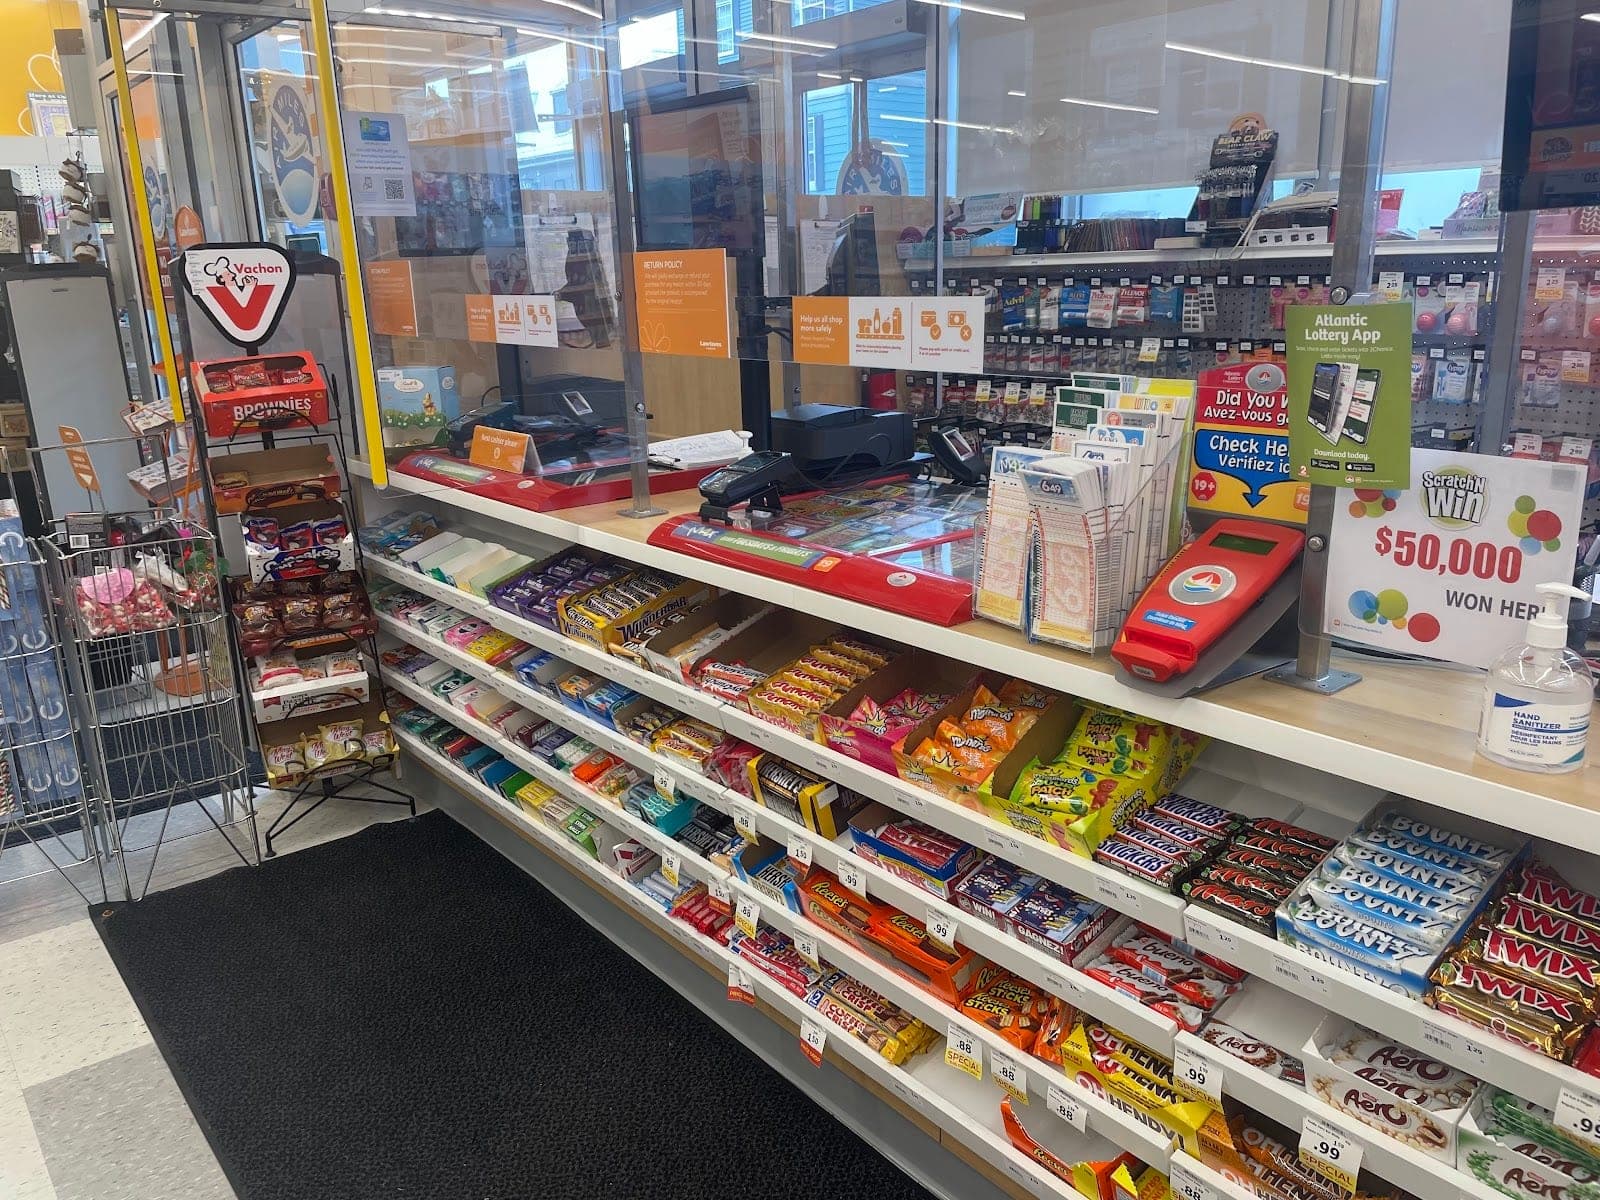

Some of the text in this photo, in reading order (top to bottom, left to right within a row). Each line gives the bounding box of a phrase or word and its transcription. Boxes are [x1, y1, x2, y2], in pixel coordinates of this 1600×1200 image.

[234, 263, 283, 274] Vachon
[643, 260, 682, 269] RETURN POLICY
[1004, 295, 1024, 305] Advil
[1120, 288, 1146, 297] TYLENOL
[800, 315, 813, 325] Help
[829, 317, 843, 326] shop
[800, 325, 832, 335] more safely
[1315, 313, 1368, 326] Atlantic
[1305, 329, 1381, 344] Lottery App
[233, 397, 312, 422] BROWNIES
[1216, 389, 1241, 406] Did
[1247, 391, 1275, 409] You
[1204, 405, 1272, 422] Avez-vous
[1209, 435, 1289, 457] Check He
[1314, 448, 1370, 461] Download today.
[1218, 454, 1290, 474] Vérifiez ic
[1194, 479, 1215, 492] 19+
[1423, 470, 1487, 494] Scratch'N
[1426, 486, 1485, 524] Win
[264, 548, 340, 571] Cupcakes
[1375, 525, 1522, 584] $50,000
[1446, 588, 1546, 622] WON HER
[616, 596, 687, 643] WUNDERBAR
[1513, 711, 1540, 721] HAND
[1513, 718, 1561, 730] SANITIZER
[1085, 722, 1121, 736] PATCH
[1031, 785, 1075, 798] PATCH
[1135, 808, 1201, 843] SNICKERS
[1118, 824, 1184, 855] SNICKERS
[1391, 815, 1511, 862] BOUNTY
[1098, 839, 1169, 873] SNICKERS
[1366, 830, 1489, 883] BOUNTY
[845, 874, 857, 887] .99
[1353, 847, 1481, 901] BOUNTY
[811, 882, 849, 908] Reese's
[1340, 865, 1467, 921] BOUNTY
[1520, 868, 1600, 920] TWI
[972, 902, 996, 920] WIN!
[1324, 882, 1448, 935] BOUNTY
[890, 913, 928, 940] Reese's
[932, 923, 947, 938] .99
[1084, 920, 1105, 943] WIN!
[1296, 907, 1416, 961] BOUNTY
[1503, 897, 1600, 950] TWIX
[1017, 926, 1064, 955] GAGNEZ!
[1142, 942, 1194, 967] bueno
[1483, 927, 1598, 988] TWIX
[831, 975, 839, 985] 2
[1117, 968, 1169, 992] bueno
[813, 993, 821, 1004] 2
[841, 992, 873, 1012] CRISP
[988, 987, 1031, 1003] STICKS
[1456, 962, 1574, 1021] TWIX
[829, 1004, 866, 1033] COFFEE
[966, 999, 1009, 1016] STICKS
[825, 1011, 855, 1032] CRISP
[957, 1040, 972, 1054] .88
[1089, 1027, 1123, 1051] OH
[1220, 1036, 1260, 1053] Aero
[947, 1051, 981, 1072] SPECIAL
[1366, 1046, 1449, 1081] Aero
[999, 1067, 1015, 1081] .88
[1185, 1068, 1206, 1085] .99
[993, 1076, 1025, 1100] SPECIAL
[1177, 1080, 1217, 1105] SPECIAL
[1354, 1067, 1428, 1105] Aero
[1056, 1104, 1074, 1121] .88
[1343, 1088, 1409, 1127] Aero
[1314, 1142, 1340, 1160] .99
[1301, 1152, 1353, 1187] SPECIAL
[1512, 1143, 1599, 1184] Aero
[1181, 1185, 1200, 1200] .88
